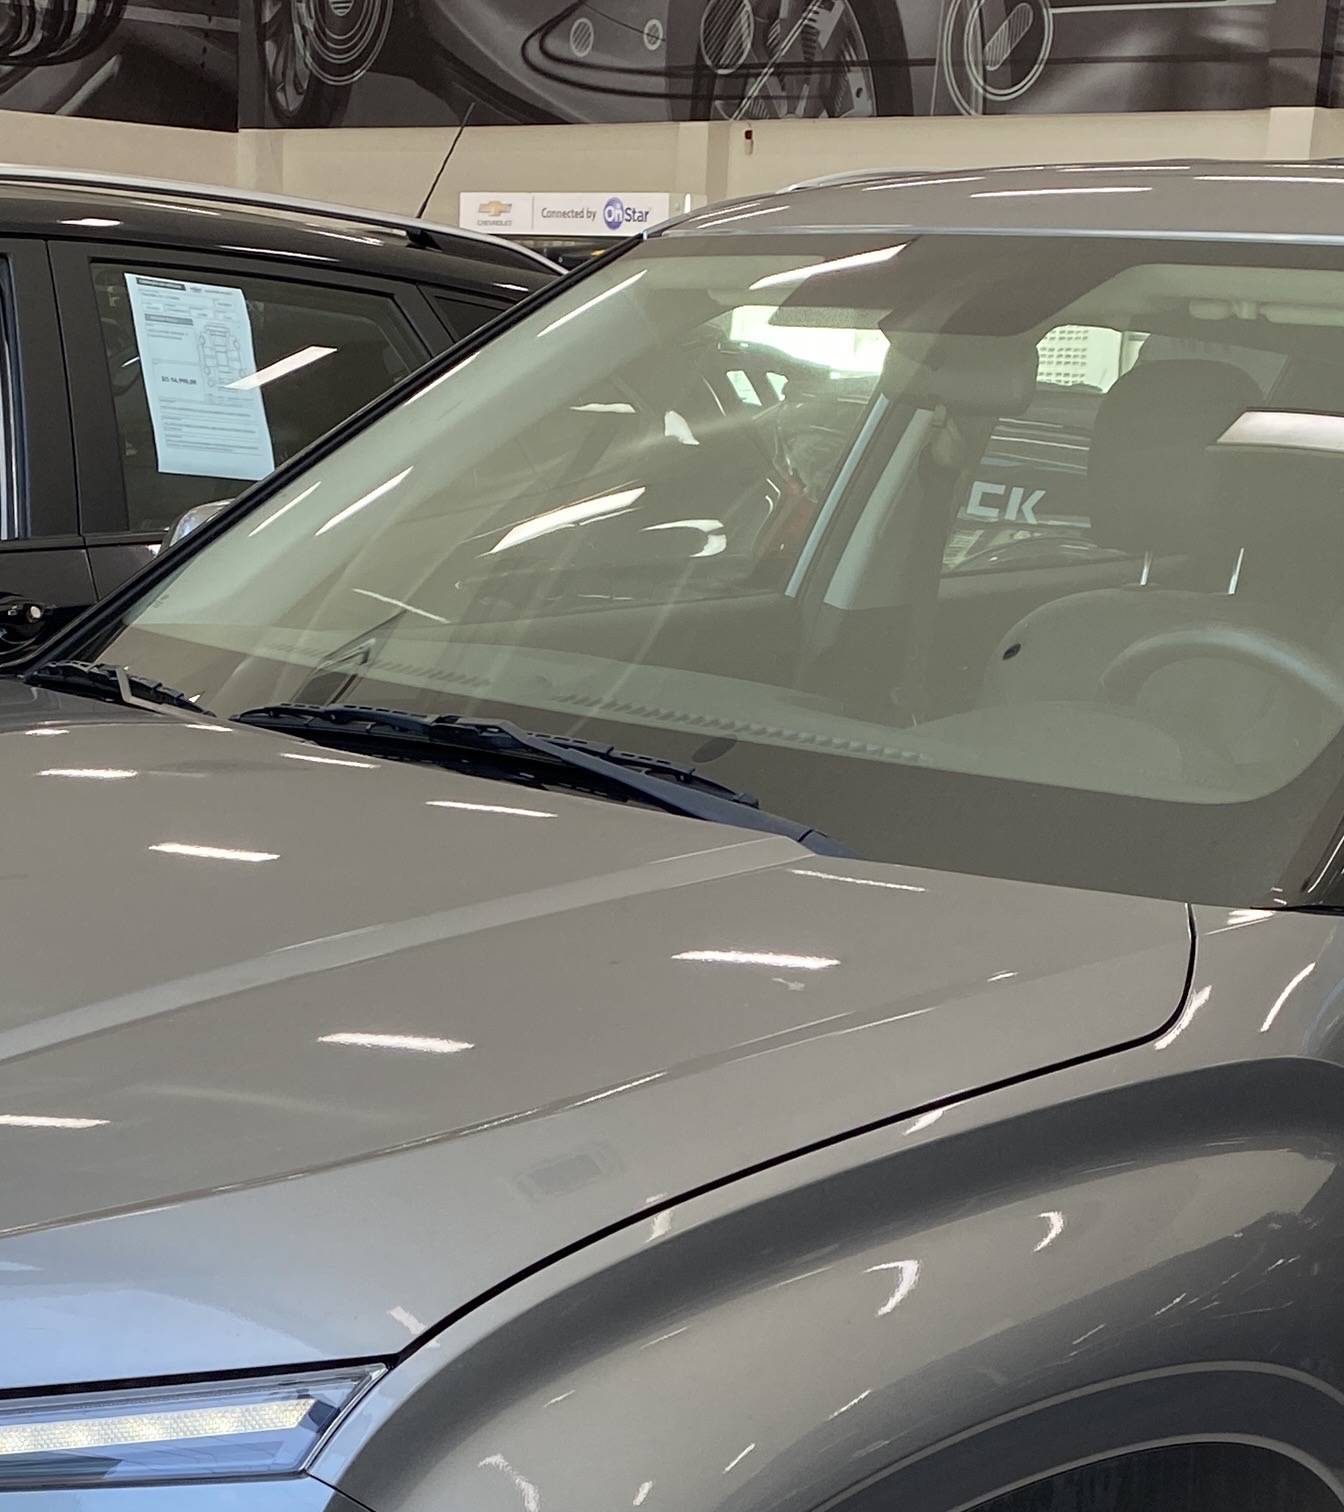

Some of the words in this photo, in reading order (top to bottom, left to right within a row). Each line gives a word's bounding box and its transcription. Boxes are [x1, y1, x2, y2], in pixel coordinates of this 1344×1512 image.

[541, 207, 585, 219] Connected
[586, 208, 597, 222] by
[476, 219, 513, 227] CHEVROLET
